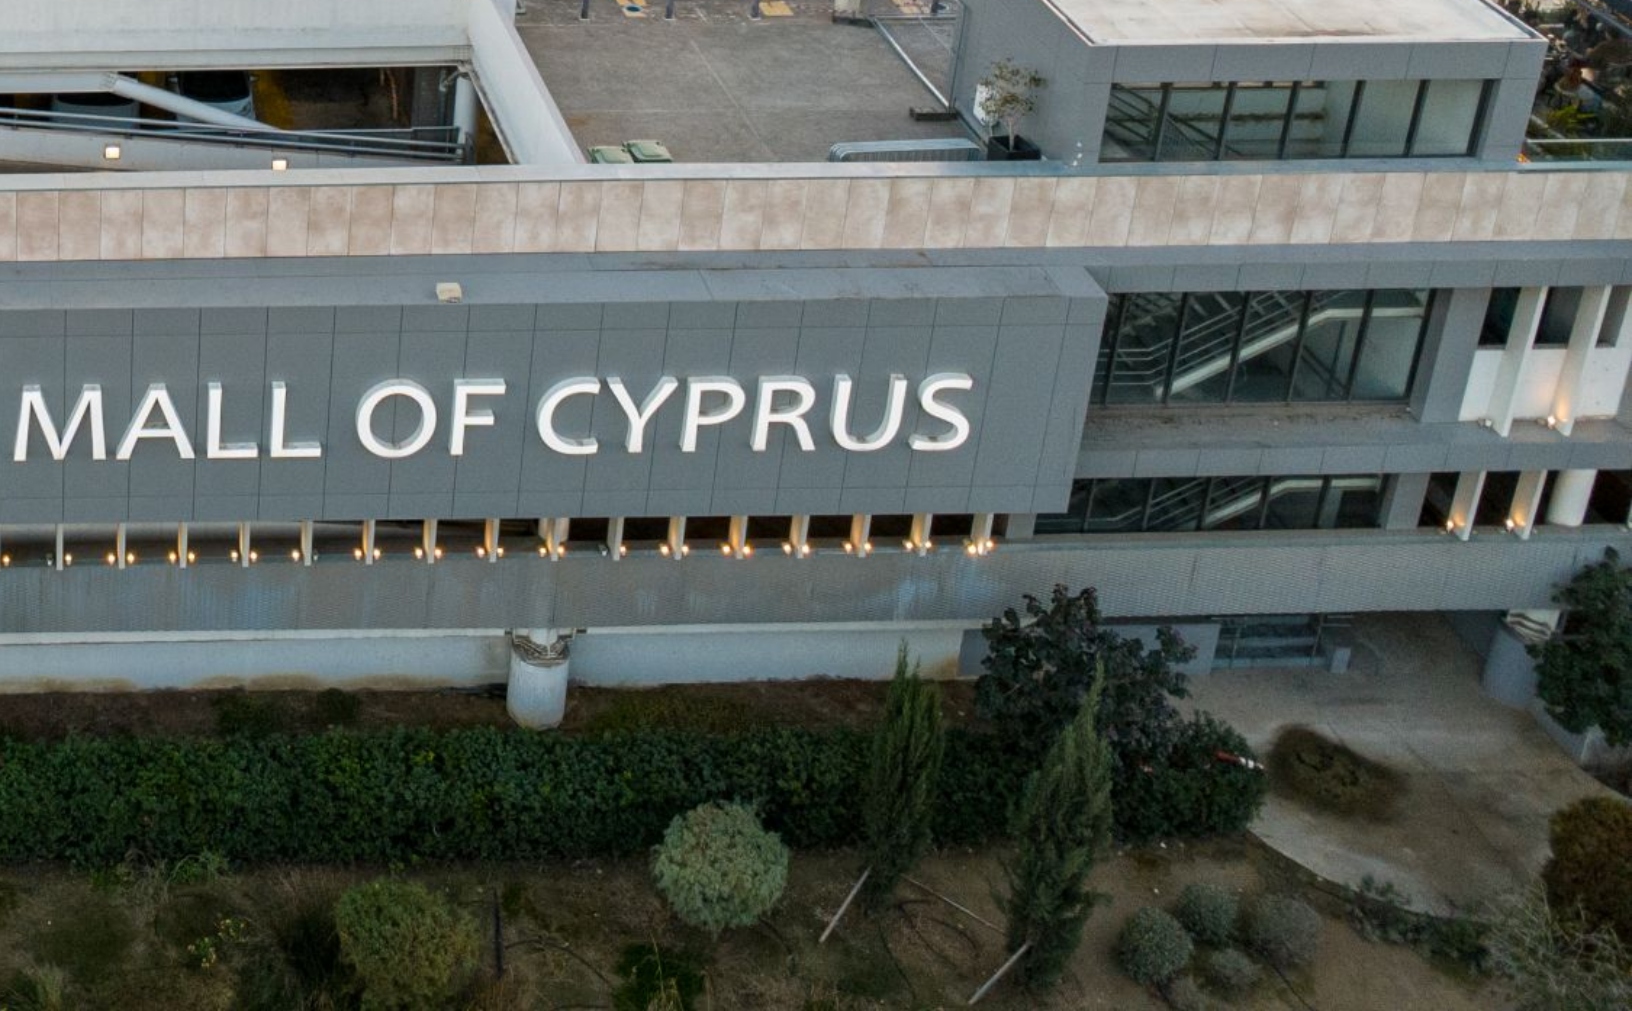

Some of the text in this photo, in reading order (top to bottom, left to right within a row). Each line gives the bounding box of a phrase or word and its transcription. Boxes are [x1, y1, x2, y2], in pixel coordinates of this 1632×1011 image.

[13, 372, 974, 462] MALL OF CYPRUS
